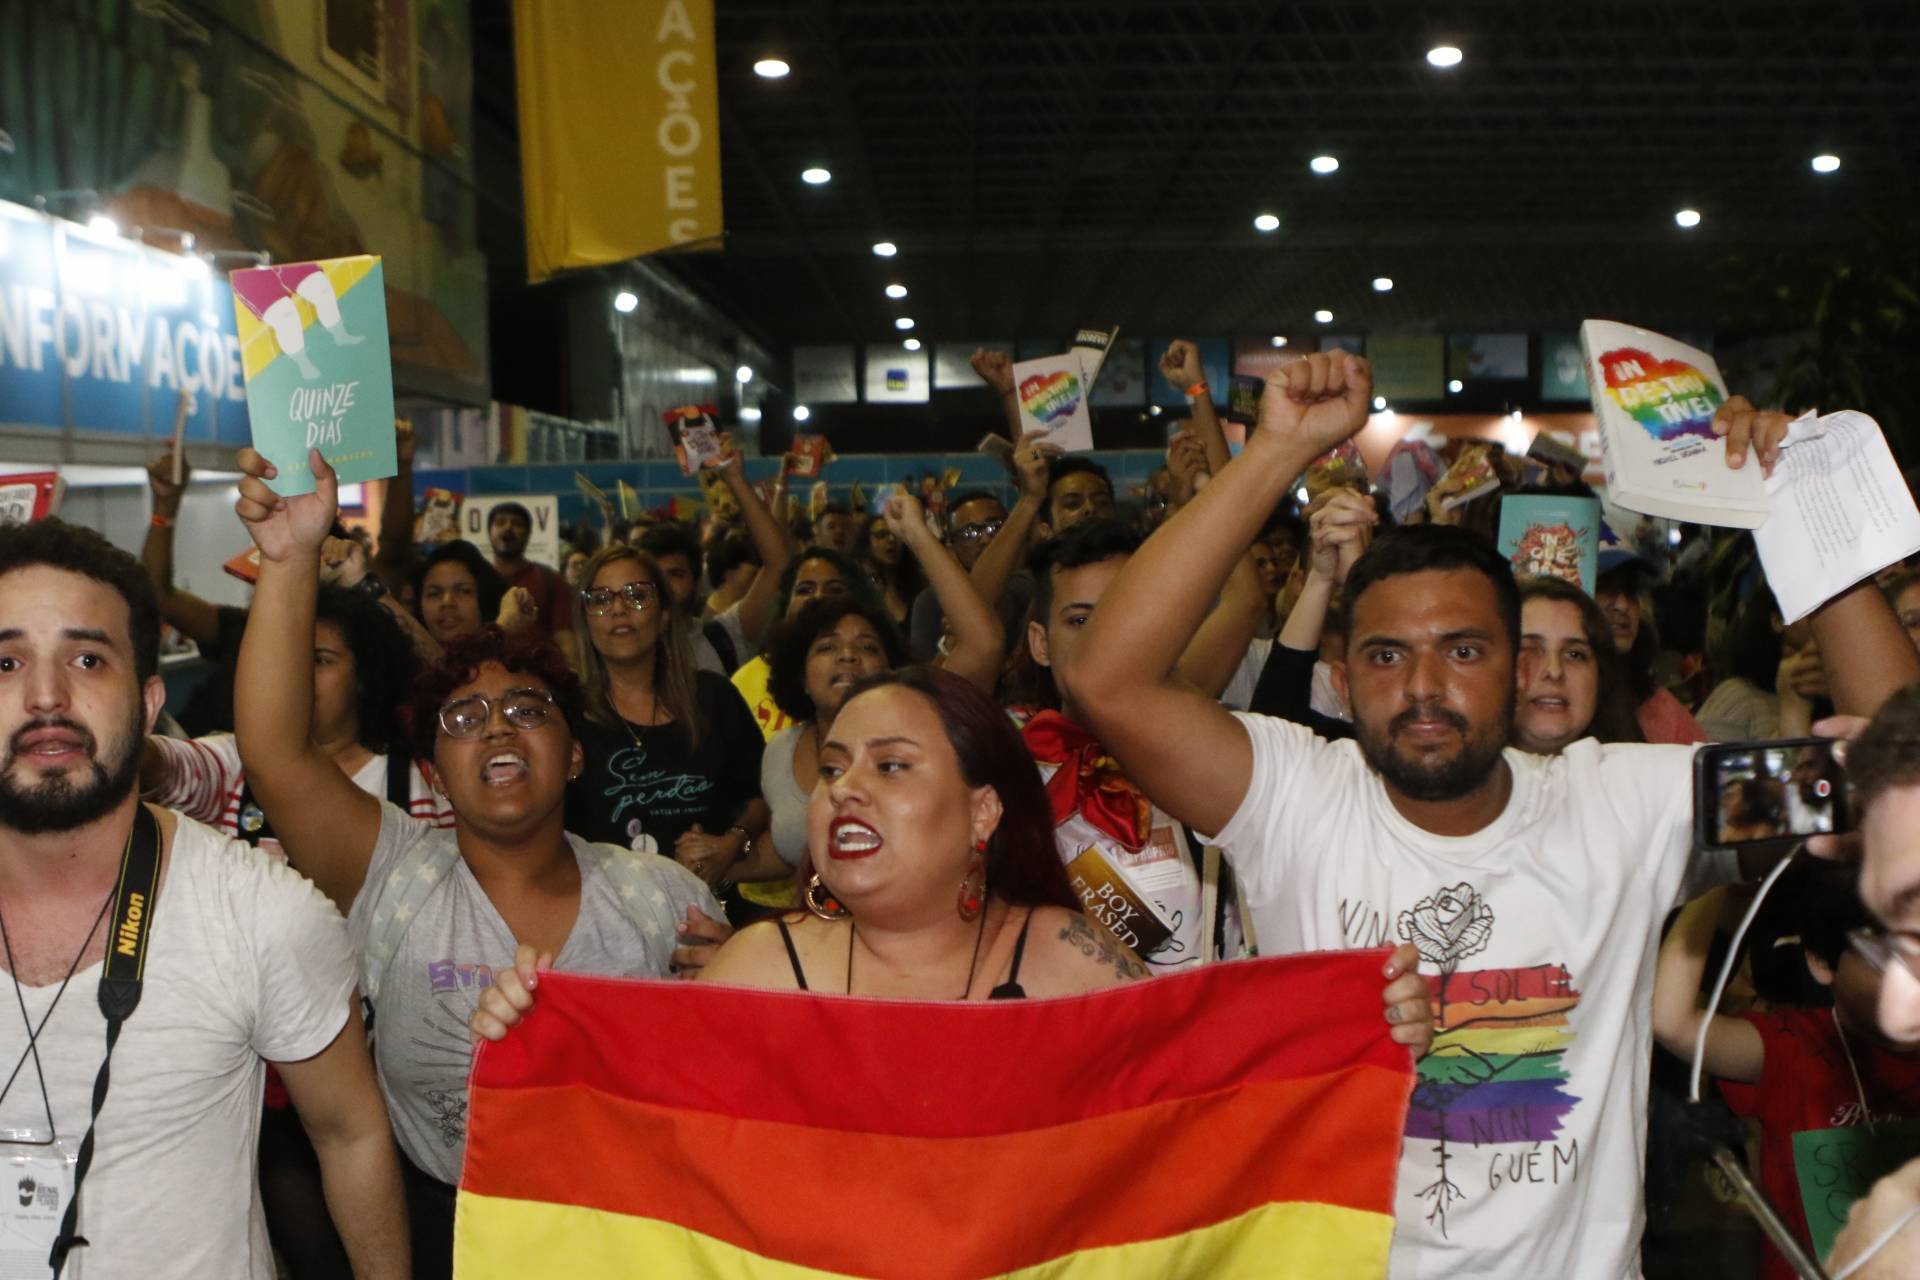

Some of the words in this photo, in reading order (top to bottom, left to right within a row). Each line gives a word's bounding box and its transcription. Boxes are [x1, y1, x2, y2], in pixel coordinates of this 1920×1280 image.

[1612, 359, 1647, 382] IN
[289, 381, 359, 422] QUINZE
[1071, 876, 1140, 949] ERASED
[1097, 881, 1140, 921] BOY
[118, 892, 145, 957] Nikon
[1468, 1104, 1532, 1149] NIN
[1488, 1138, 1579, 1190] GUÉM
